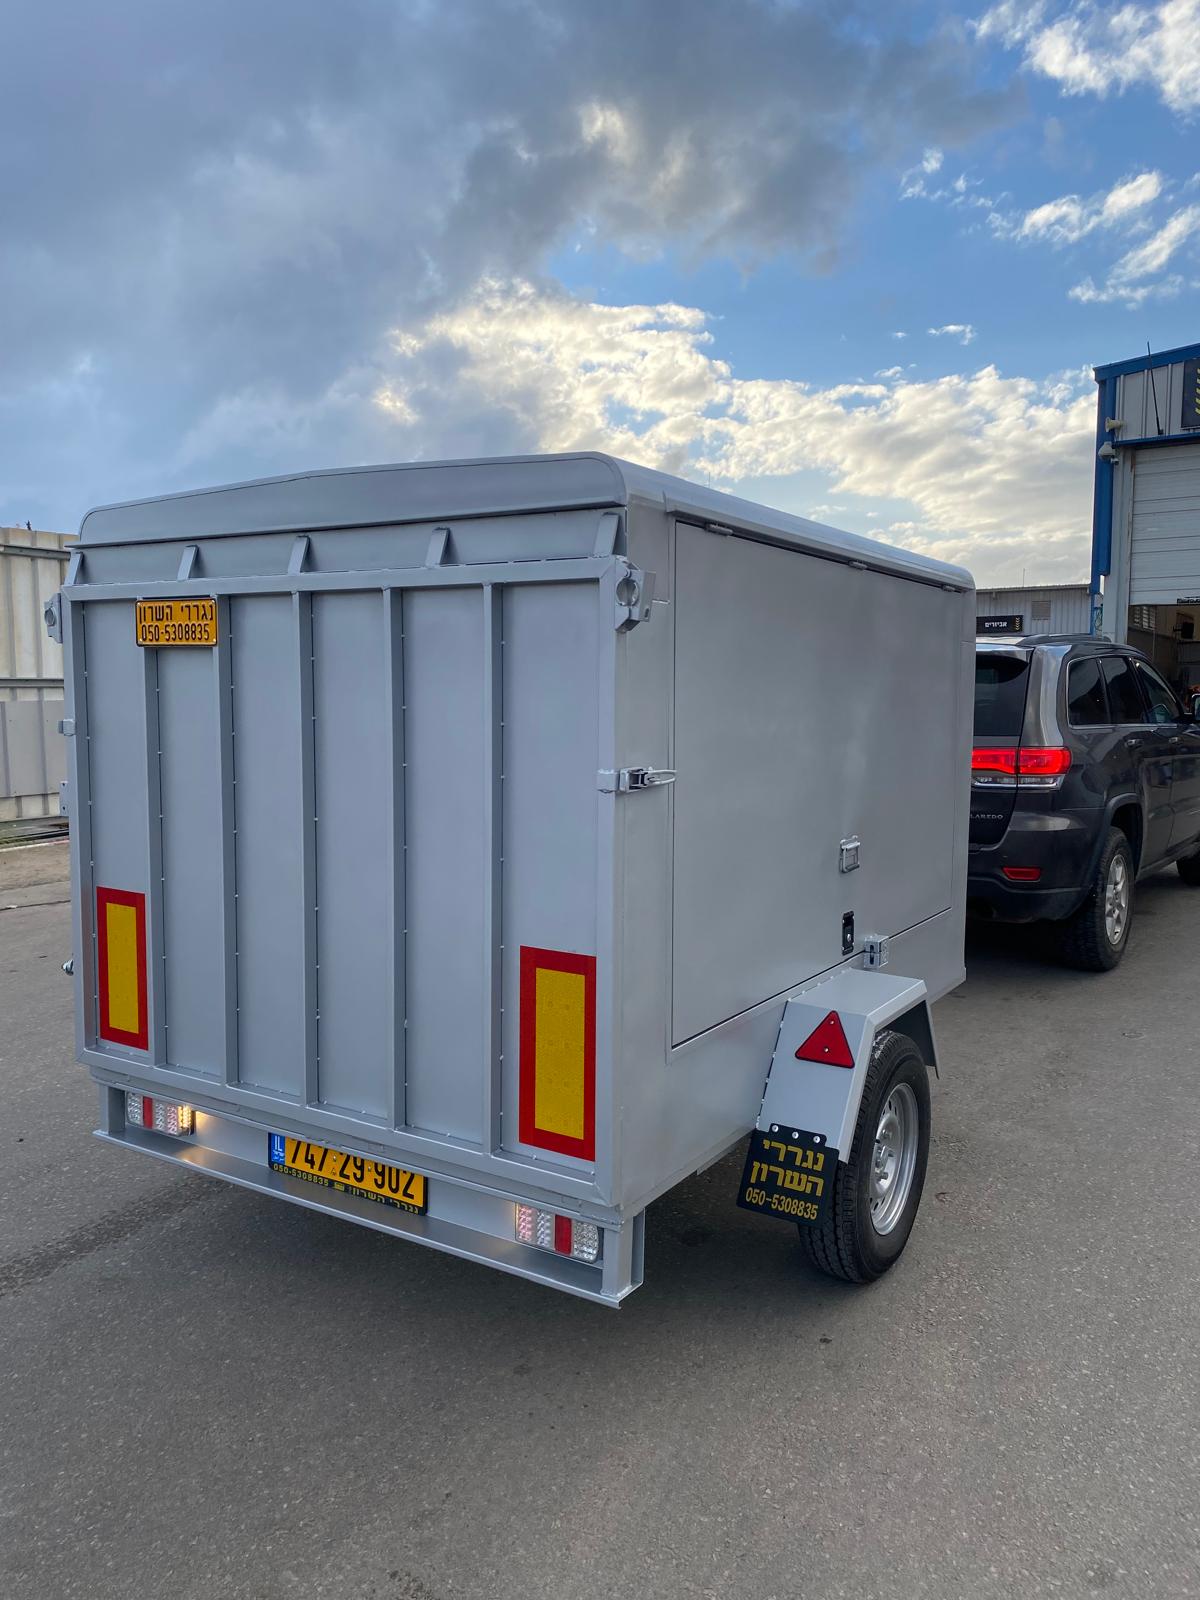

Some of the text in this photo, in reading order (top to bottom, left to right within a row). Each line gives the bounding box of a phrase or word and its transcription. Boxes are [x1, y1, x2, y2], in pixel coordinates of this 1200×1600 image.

[140, 604, 213, 624] נגררי השרון
[141, 623, 209, 641] 050-5308835
[763, 1139, 825, 1171] נגררי
[273, 1163, 329, 1186] 050-5308835
[750, 1161, 824, 1197] השרון
[745, 1187, 819, 1220] 050-5308835
